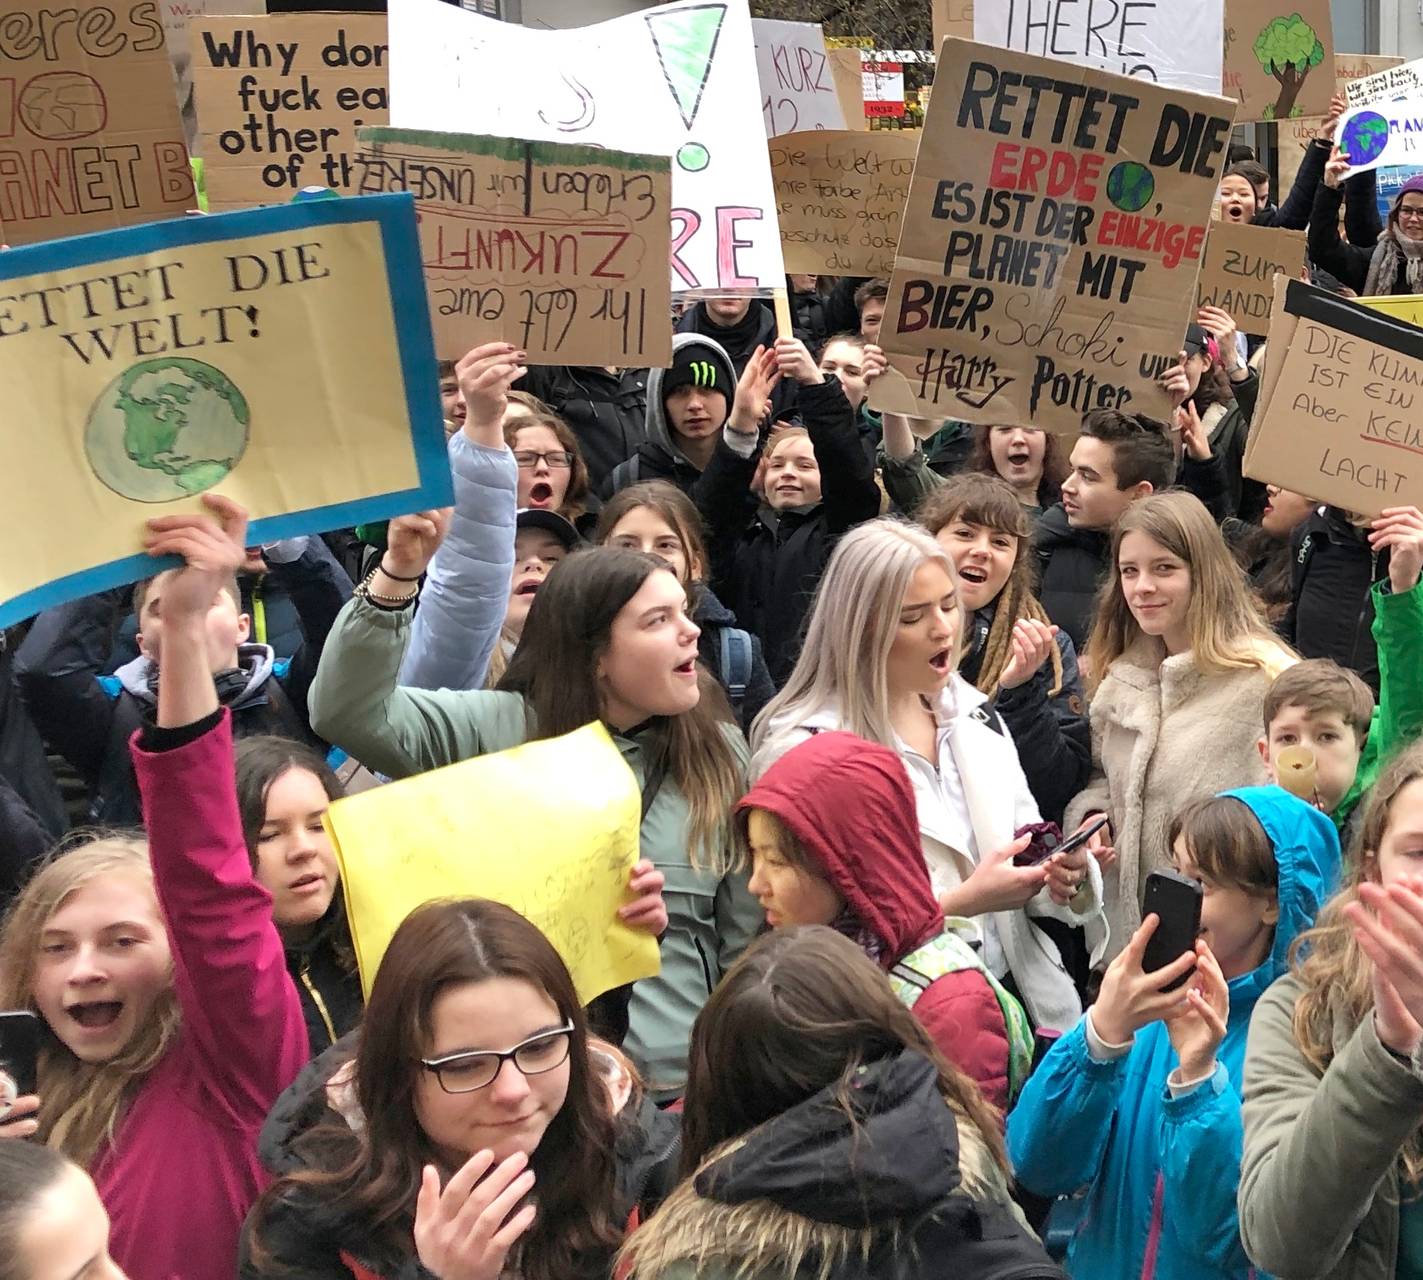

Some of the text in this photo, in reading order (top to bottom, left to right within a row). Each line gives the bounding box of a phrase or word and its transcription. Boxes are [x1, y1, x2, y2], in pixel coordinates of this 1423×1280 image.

[203, 30, 298, 76] Why
[771, 44, 833, 94] KURZ
[238, 75, 320, 111] fuck
[219, 114, 339, 155] other
[957, 61, 1233, 178] RETTET DIE
[153, 141, 196, 203] B
[262, 153, 301, 188] of
[826, 144, 880, 175] Welt
[988, 142, 1106, 203] ERDE
[543, 171, 657, 222] Erleben
[801, 204, 847, 220] muss
[931, 180, 977, 225] ES
[978, 187, 1036, 231] IST
[1034, 197, 1095, 246] DER
[1096, 209, 1205, 269] EINZIGE
[226, 243, 330, 293] DIE
[825, 251, 851, 270] du
[943, 230, 1147, 305] PLANET MIT
[434, 287, 505, 321] eure
[590, 288, 645, 354] Ihr
[60, 305, 260, 365] WELT!
[896, 279, 1180, 382] BIER, Schoki UN
[1304, 325, 1356, 364] DIE
[915, 347, 1134, 421] Harry Potter
[1292, 392, 1350, 424] Aber
[1308, 364, 1350, 390] IST
[1363, 382, 1414, 409] EIN
[1319, 447, 1408, 494] LACHT
